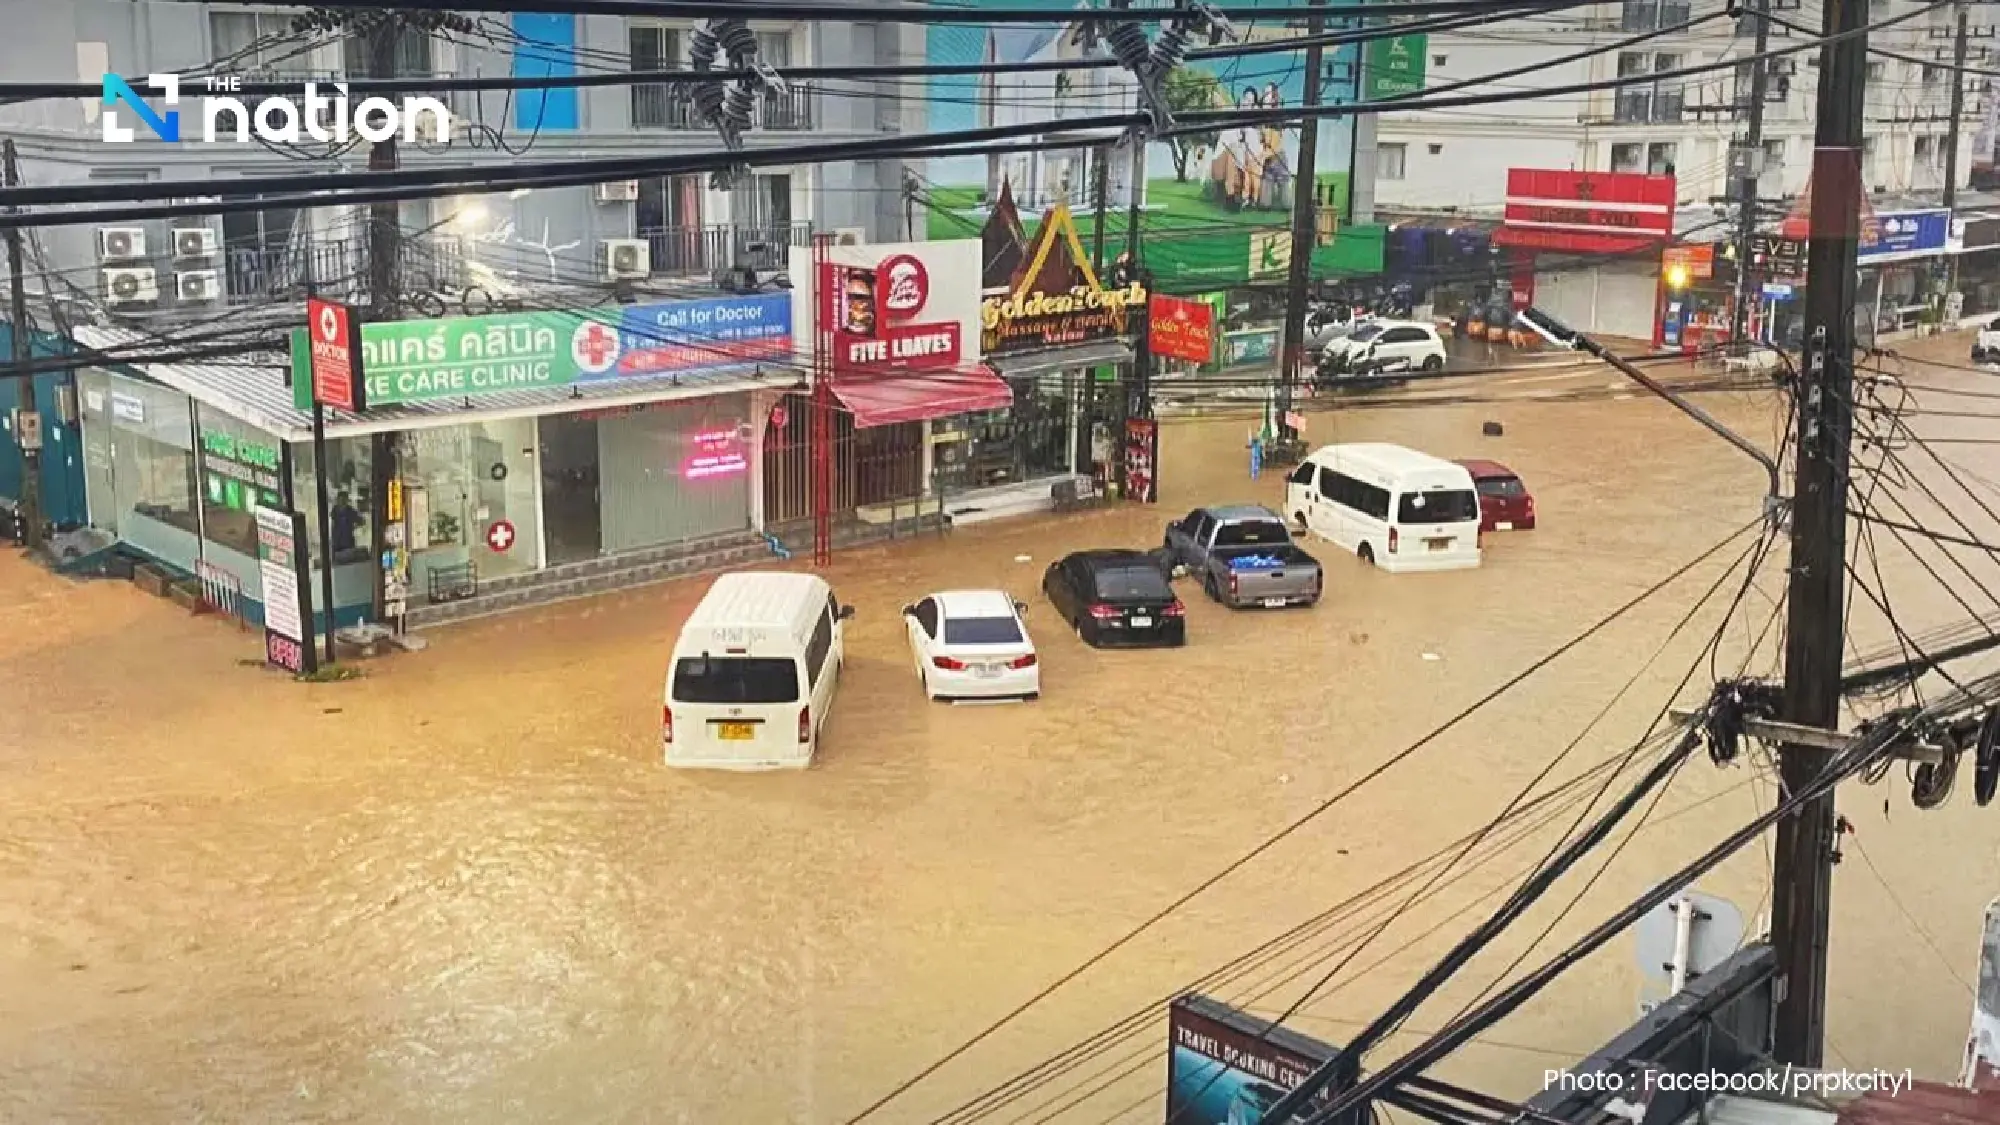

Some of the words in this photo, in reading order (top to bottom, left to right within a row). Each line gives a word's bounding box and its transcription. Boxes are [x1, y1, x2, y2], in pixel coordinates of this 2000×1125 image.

[656, 309, 687, 326] Call
[691, 307, 712, 325] for
[715, 305, 763, 321] Doctor
[983, 290, 1073, 329] Golden
[397, 368, 465, 393] CARE
[471, 361, 550, 387] CLINIC
[1177, 1024, 1221, 1058] TRAVEL
